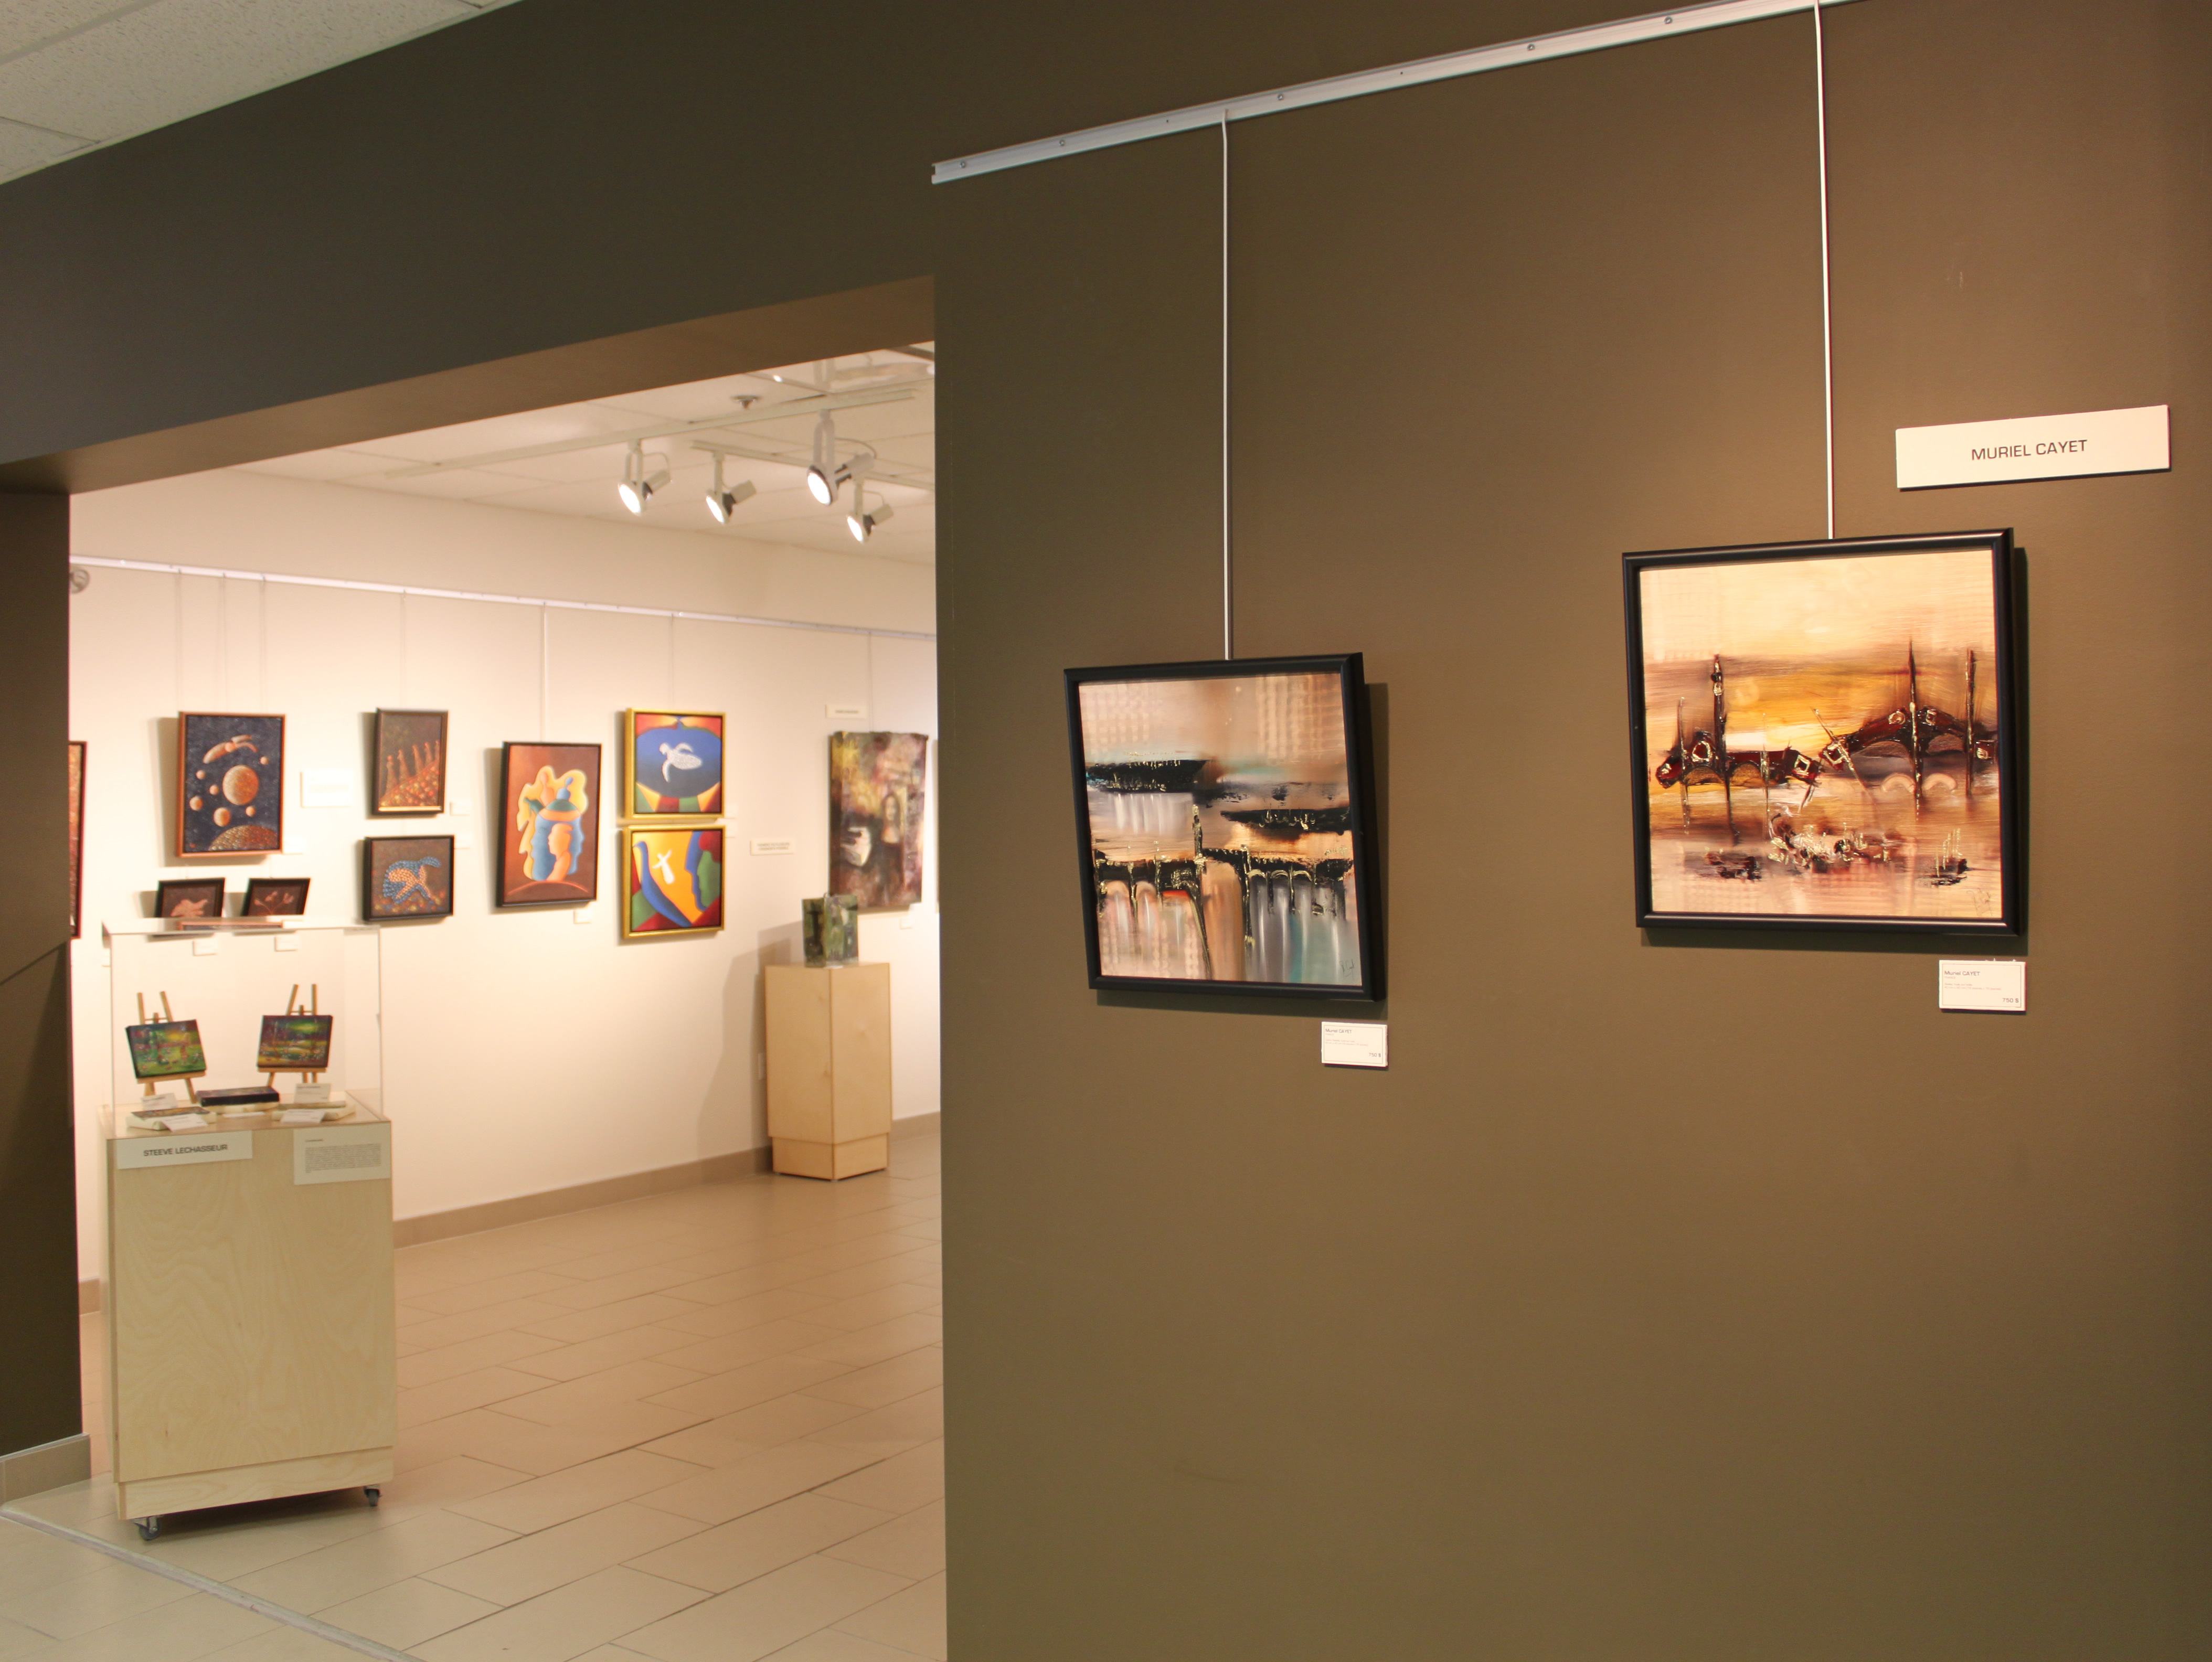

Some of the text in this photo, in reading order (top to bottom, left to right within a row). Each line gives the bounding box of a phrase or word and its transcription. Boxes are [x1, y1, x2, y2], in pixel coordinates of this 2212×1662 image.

[1971, 439, 2088, 461] MURIEL CAYET
[143, 1144, 228, 1157] STEEVE LECHASSEUR
